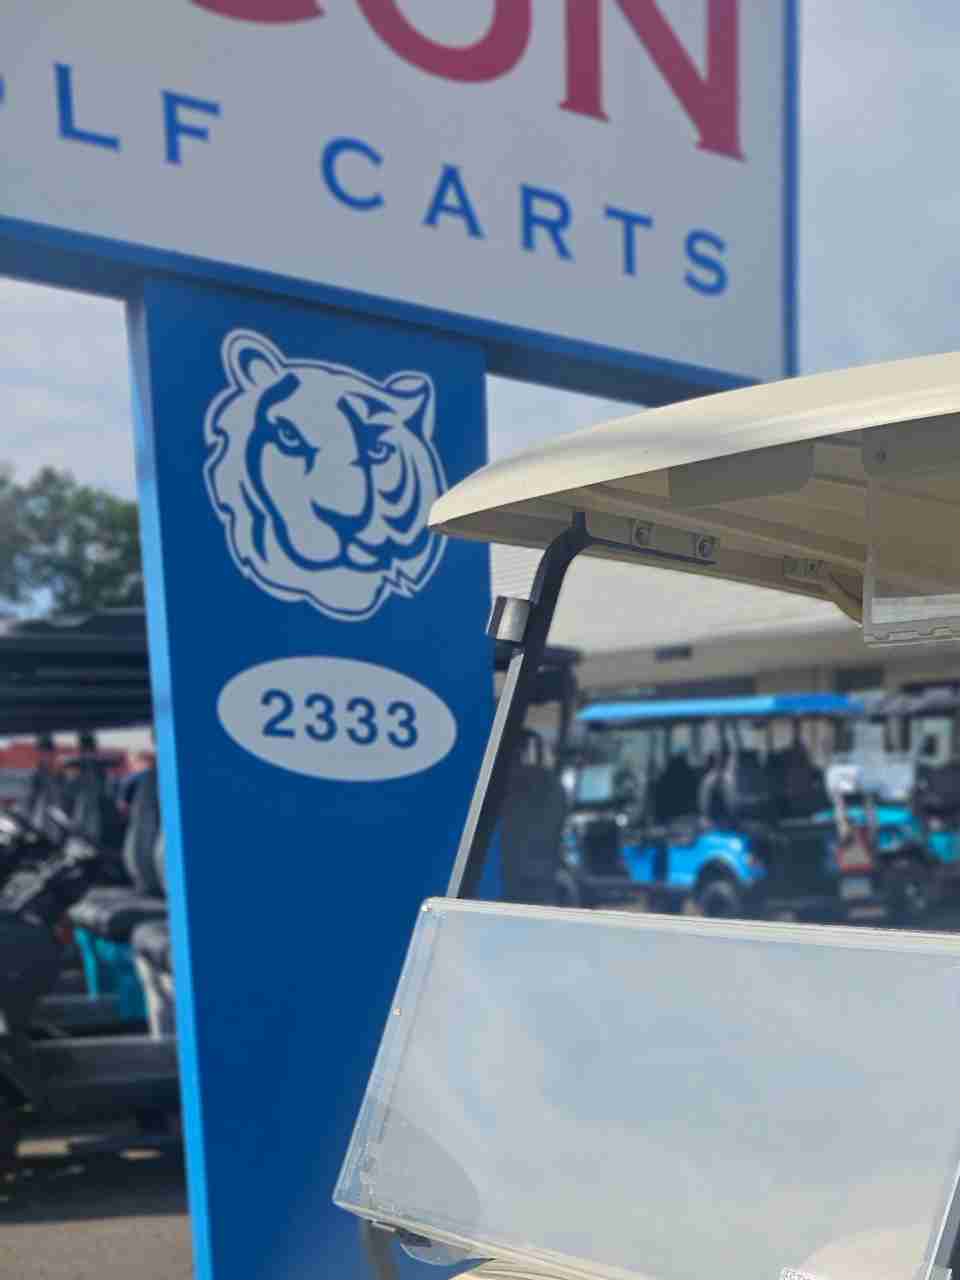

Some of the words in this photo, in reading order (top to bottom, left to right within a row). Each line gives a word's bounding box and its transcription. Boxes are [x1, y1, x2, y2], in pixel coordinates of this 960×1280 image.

[0, 63, 221, 165] LF
[320, 136, 730, 297] CARTS
[259, 688, 419, 750] 2333
